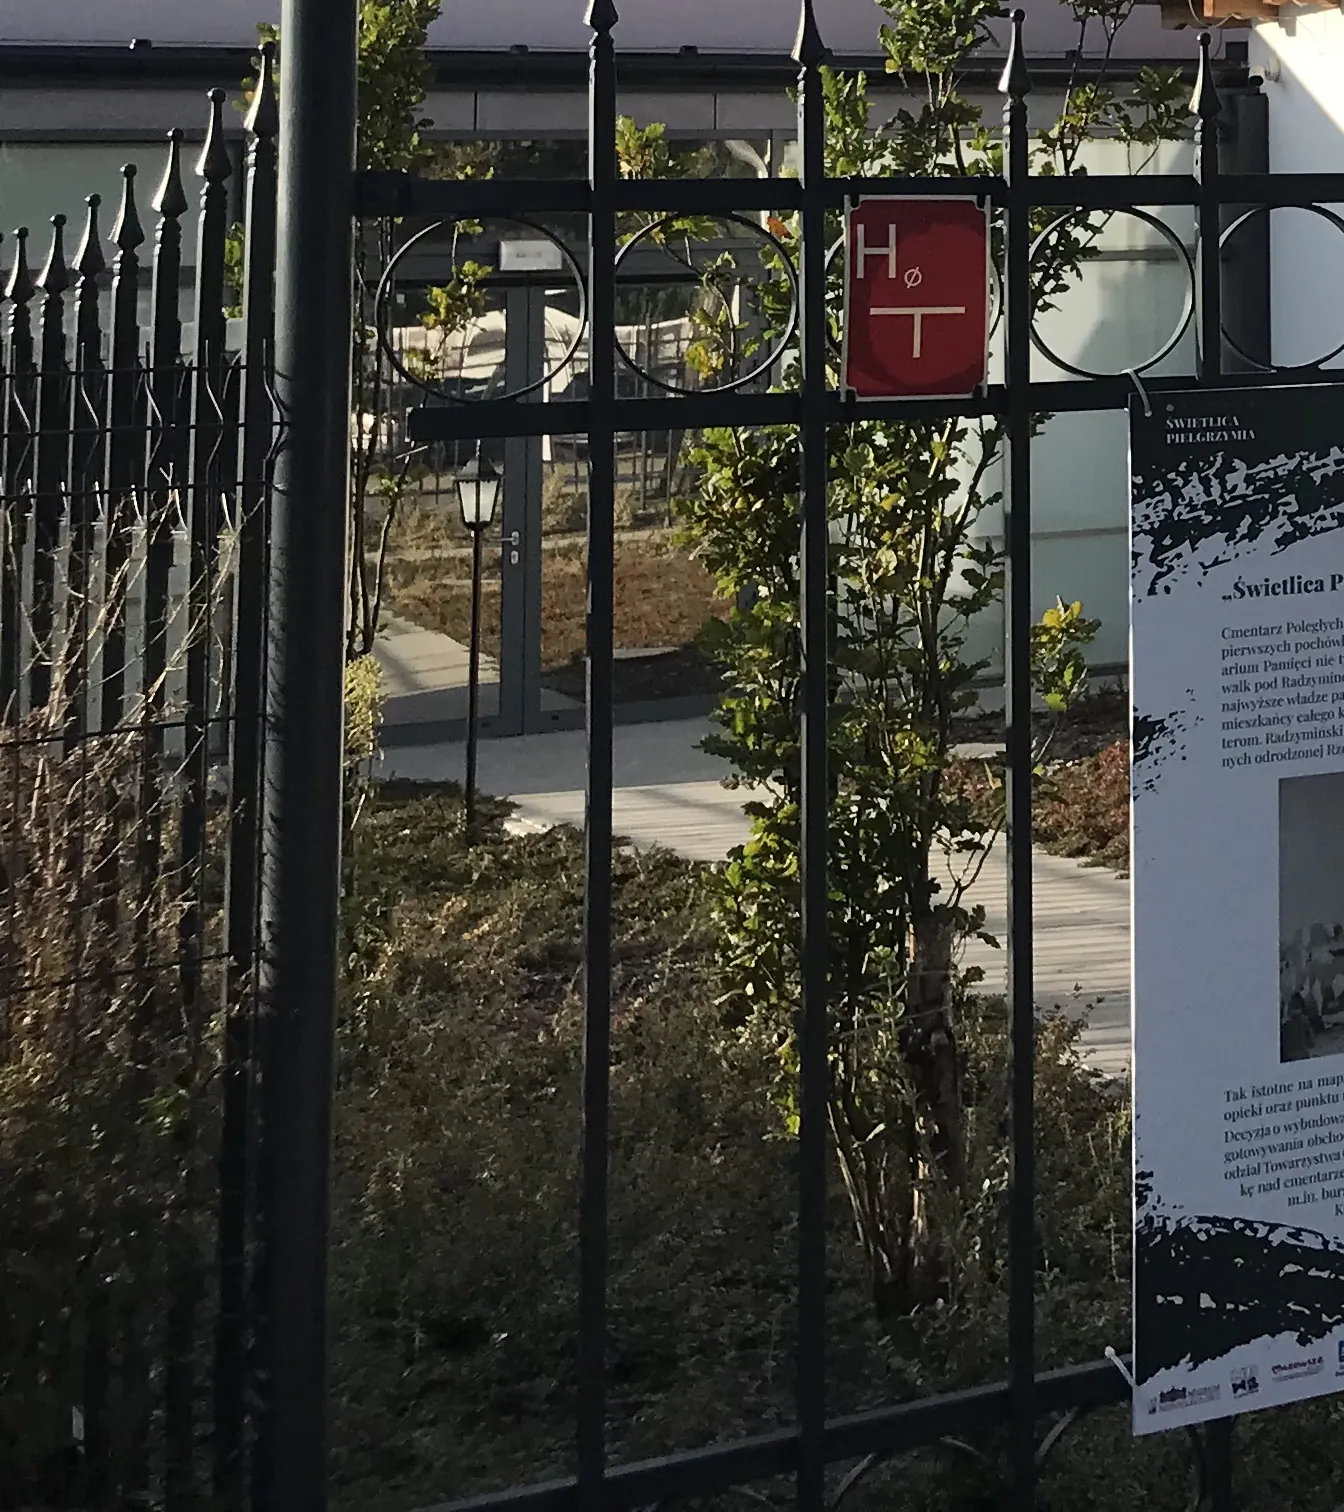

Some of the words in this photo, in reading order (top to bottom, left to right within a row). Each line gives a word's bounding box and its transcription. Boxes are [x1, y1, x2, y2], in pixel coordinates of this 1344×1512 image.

[856, 224, 896, 279] H
[1166, 430, 1255, 444] PIELGRZYMIA
[1221, 626, 1282, 639] Cmentarz
[1286, 616, 1343, 634] Poległych
[1221, 639, 1290, 660] pierwszych
[1221, 662, 1258, 675] arium
[1263, 655, 1311, 671] Pamięci
[1315, 654, 1334, 666] nie
[1221, 678, 1250, 693] walk
[1254, 676, 1277, 693] pod
[1221, 696, 1284, 712] najwyższe
[1286, 690, 1327, 705] władze
[1296, 708, 1334, 722] całego
[1221, 750, 1251, 767] nych
[1254, 743, 1323, 761] odrodzonej
[1223, 1086, 1246, 1101] Tak
[1251, 1082, 1293, 1097] istotne
[1298, 1080, 1312, 1089] na
